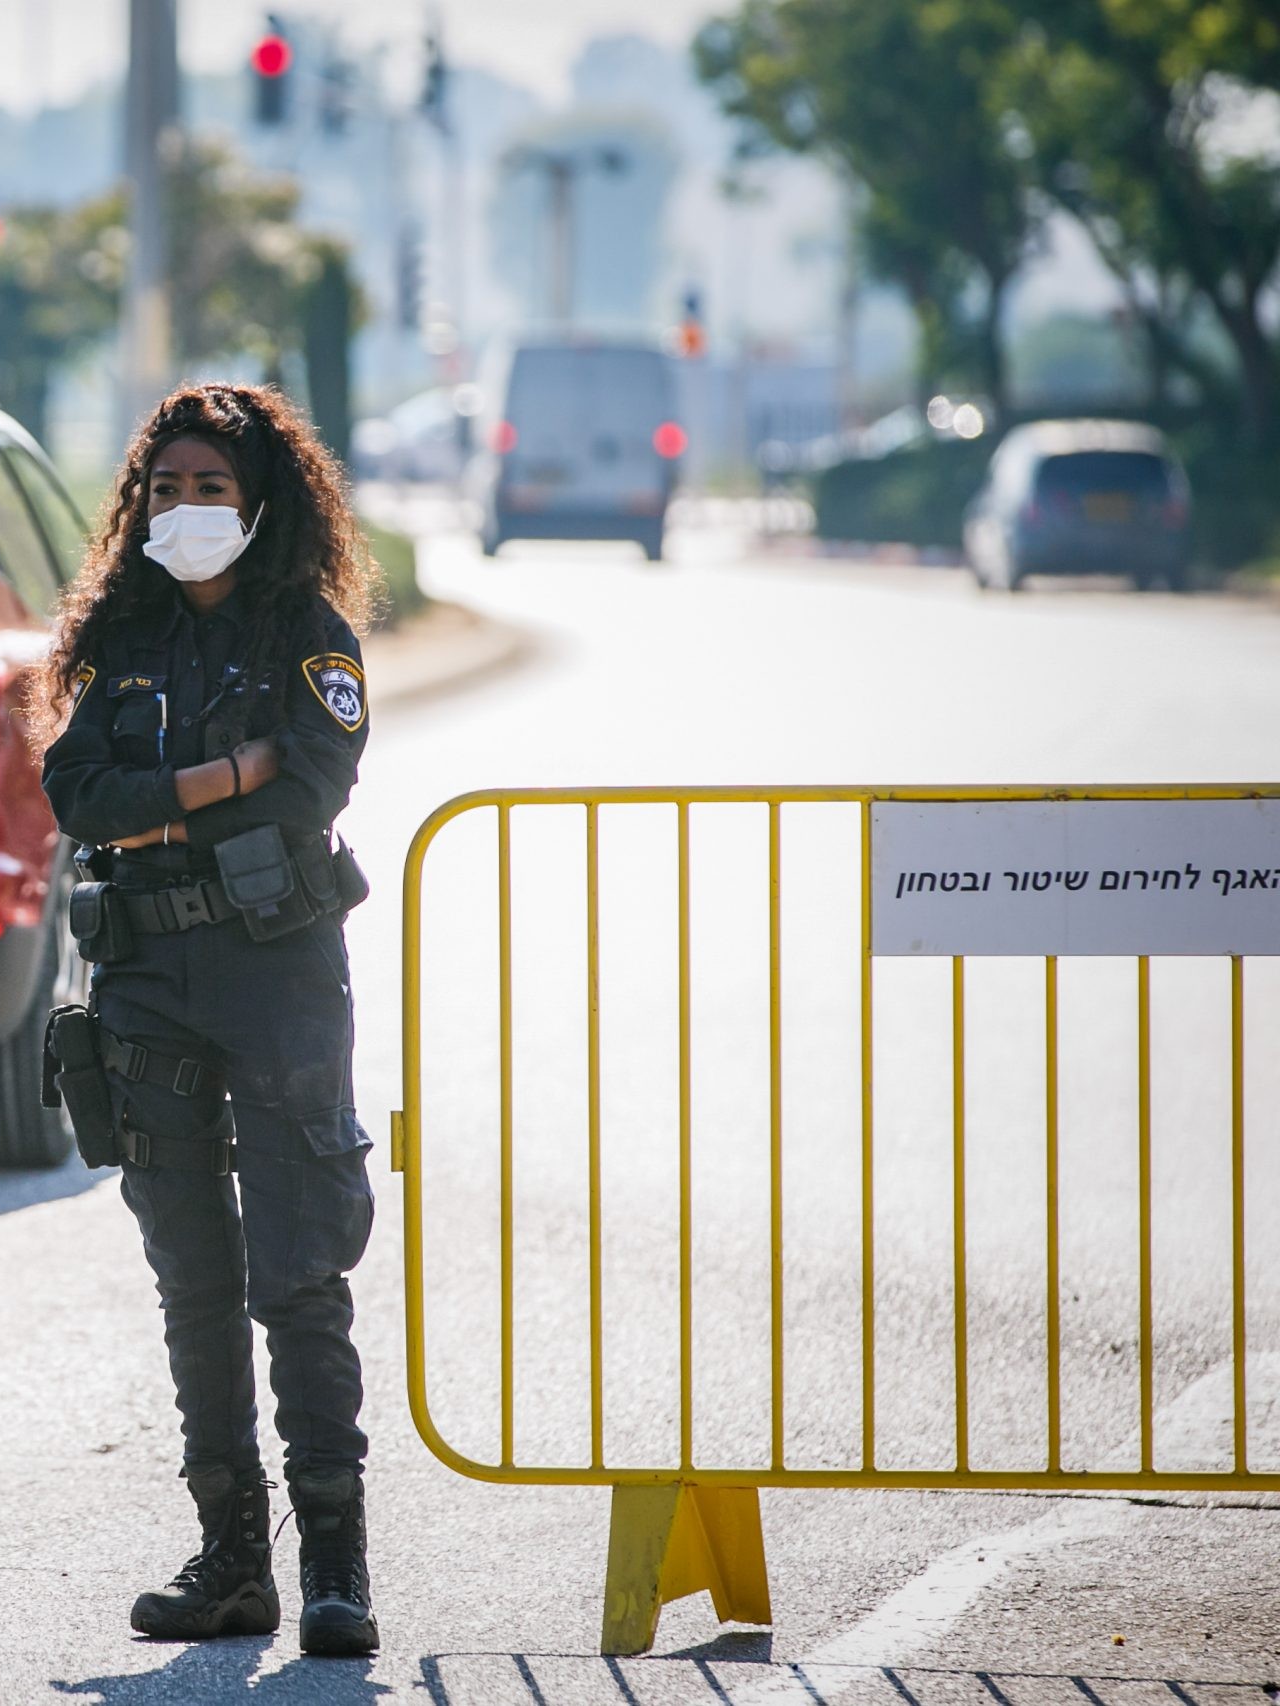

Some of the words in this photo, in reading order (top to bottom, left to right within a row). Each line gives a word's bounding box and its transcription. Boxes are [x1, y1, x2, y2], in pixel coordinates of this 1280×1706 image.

[896, 871, 991, 899] ובטחון
[1003, 870, 1089, 891] שיטור
[1099, 863, 1201, 890] לחירום
